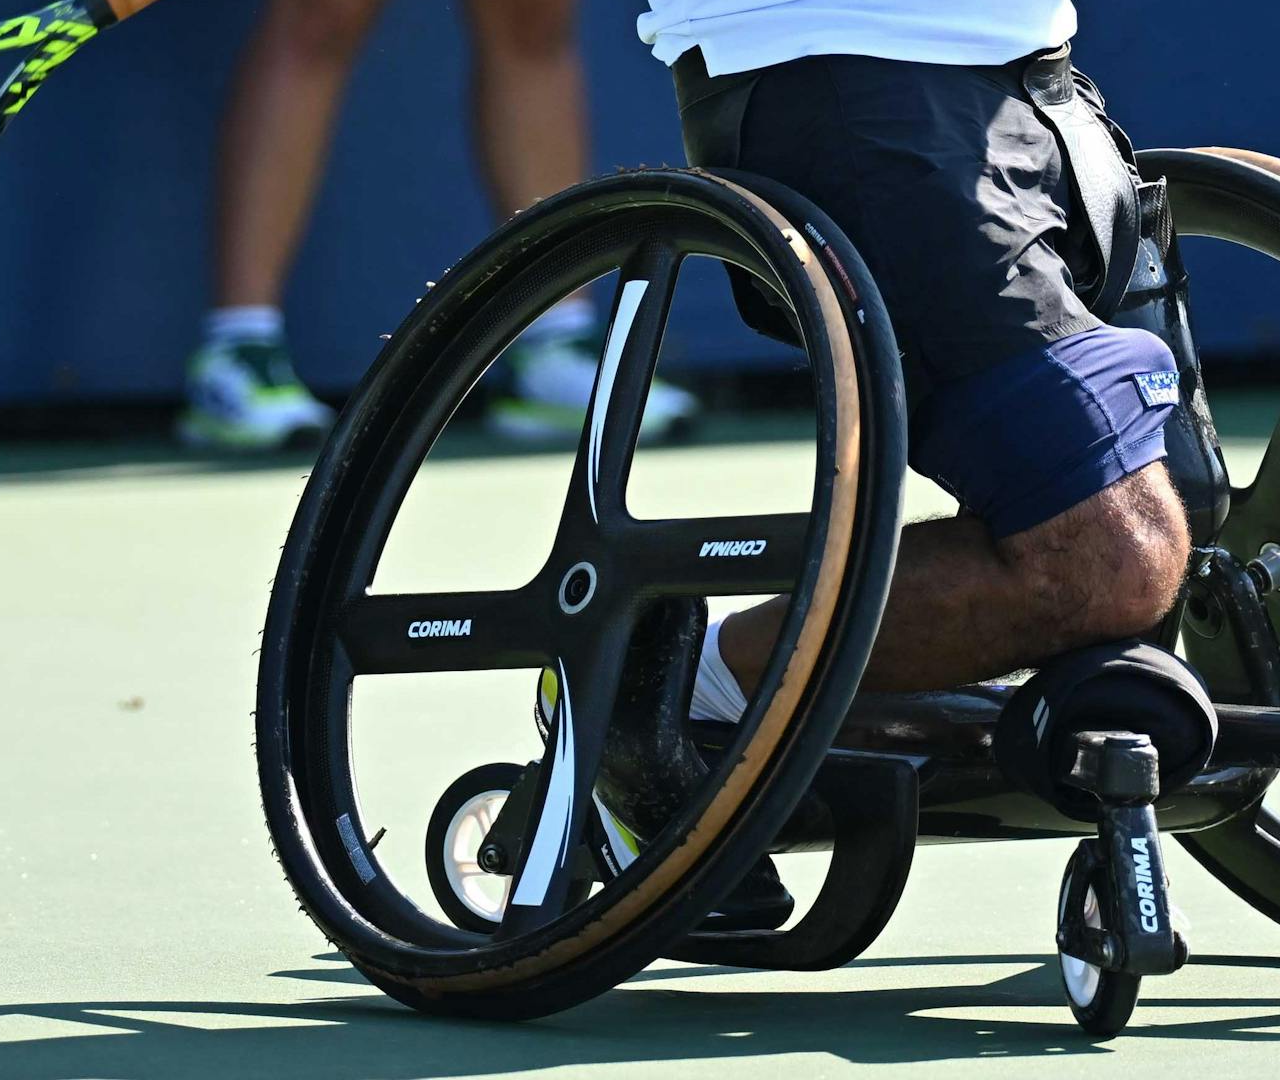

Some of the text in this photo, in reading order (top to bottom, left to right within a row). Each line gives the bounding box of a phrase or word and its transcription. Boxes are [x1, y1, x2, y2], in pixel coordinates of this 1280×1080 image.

[699, 540, 767, 557] CORIMA
[407, 619, 472, 638] CORIMA
[1130, 837, 1159, 933] CORIMA
